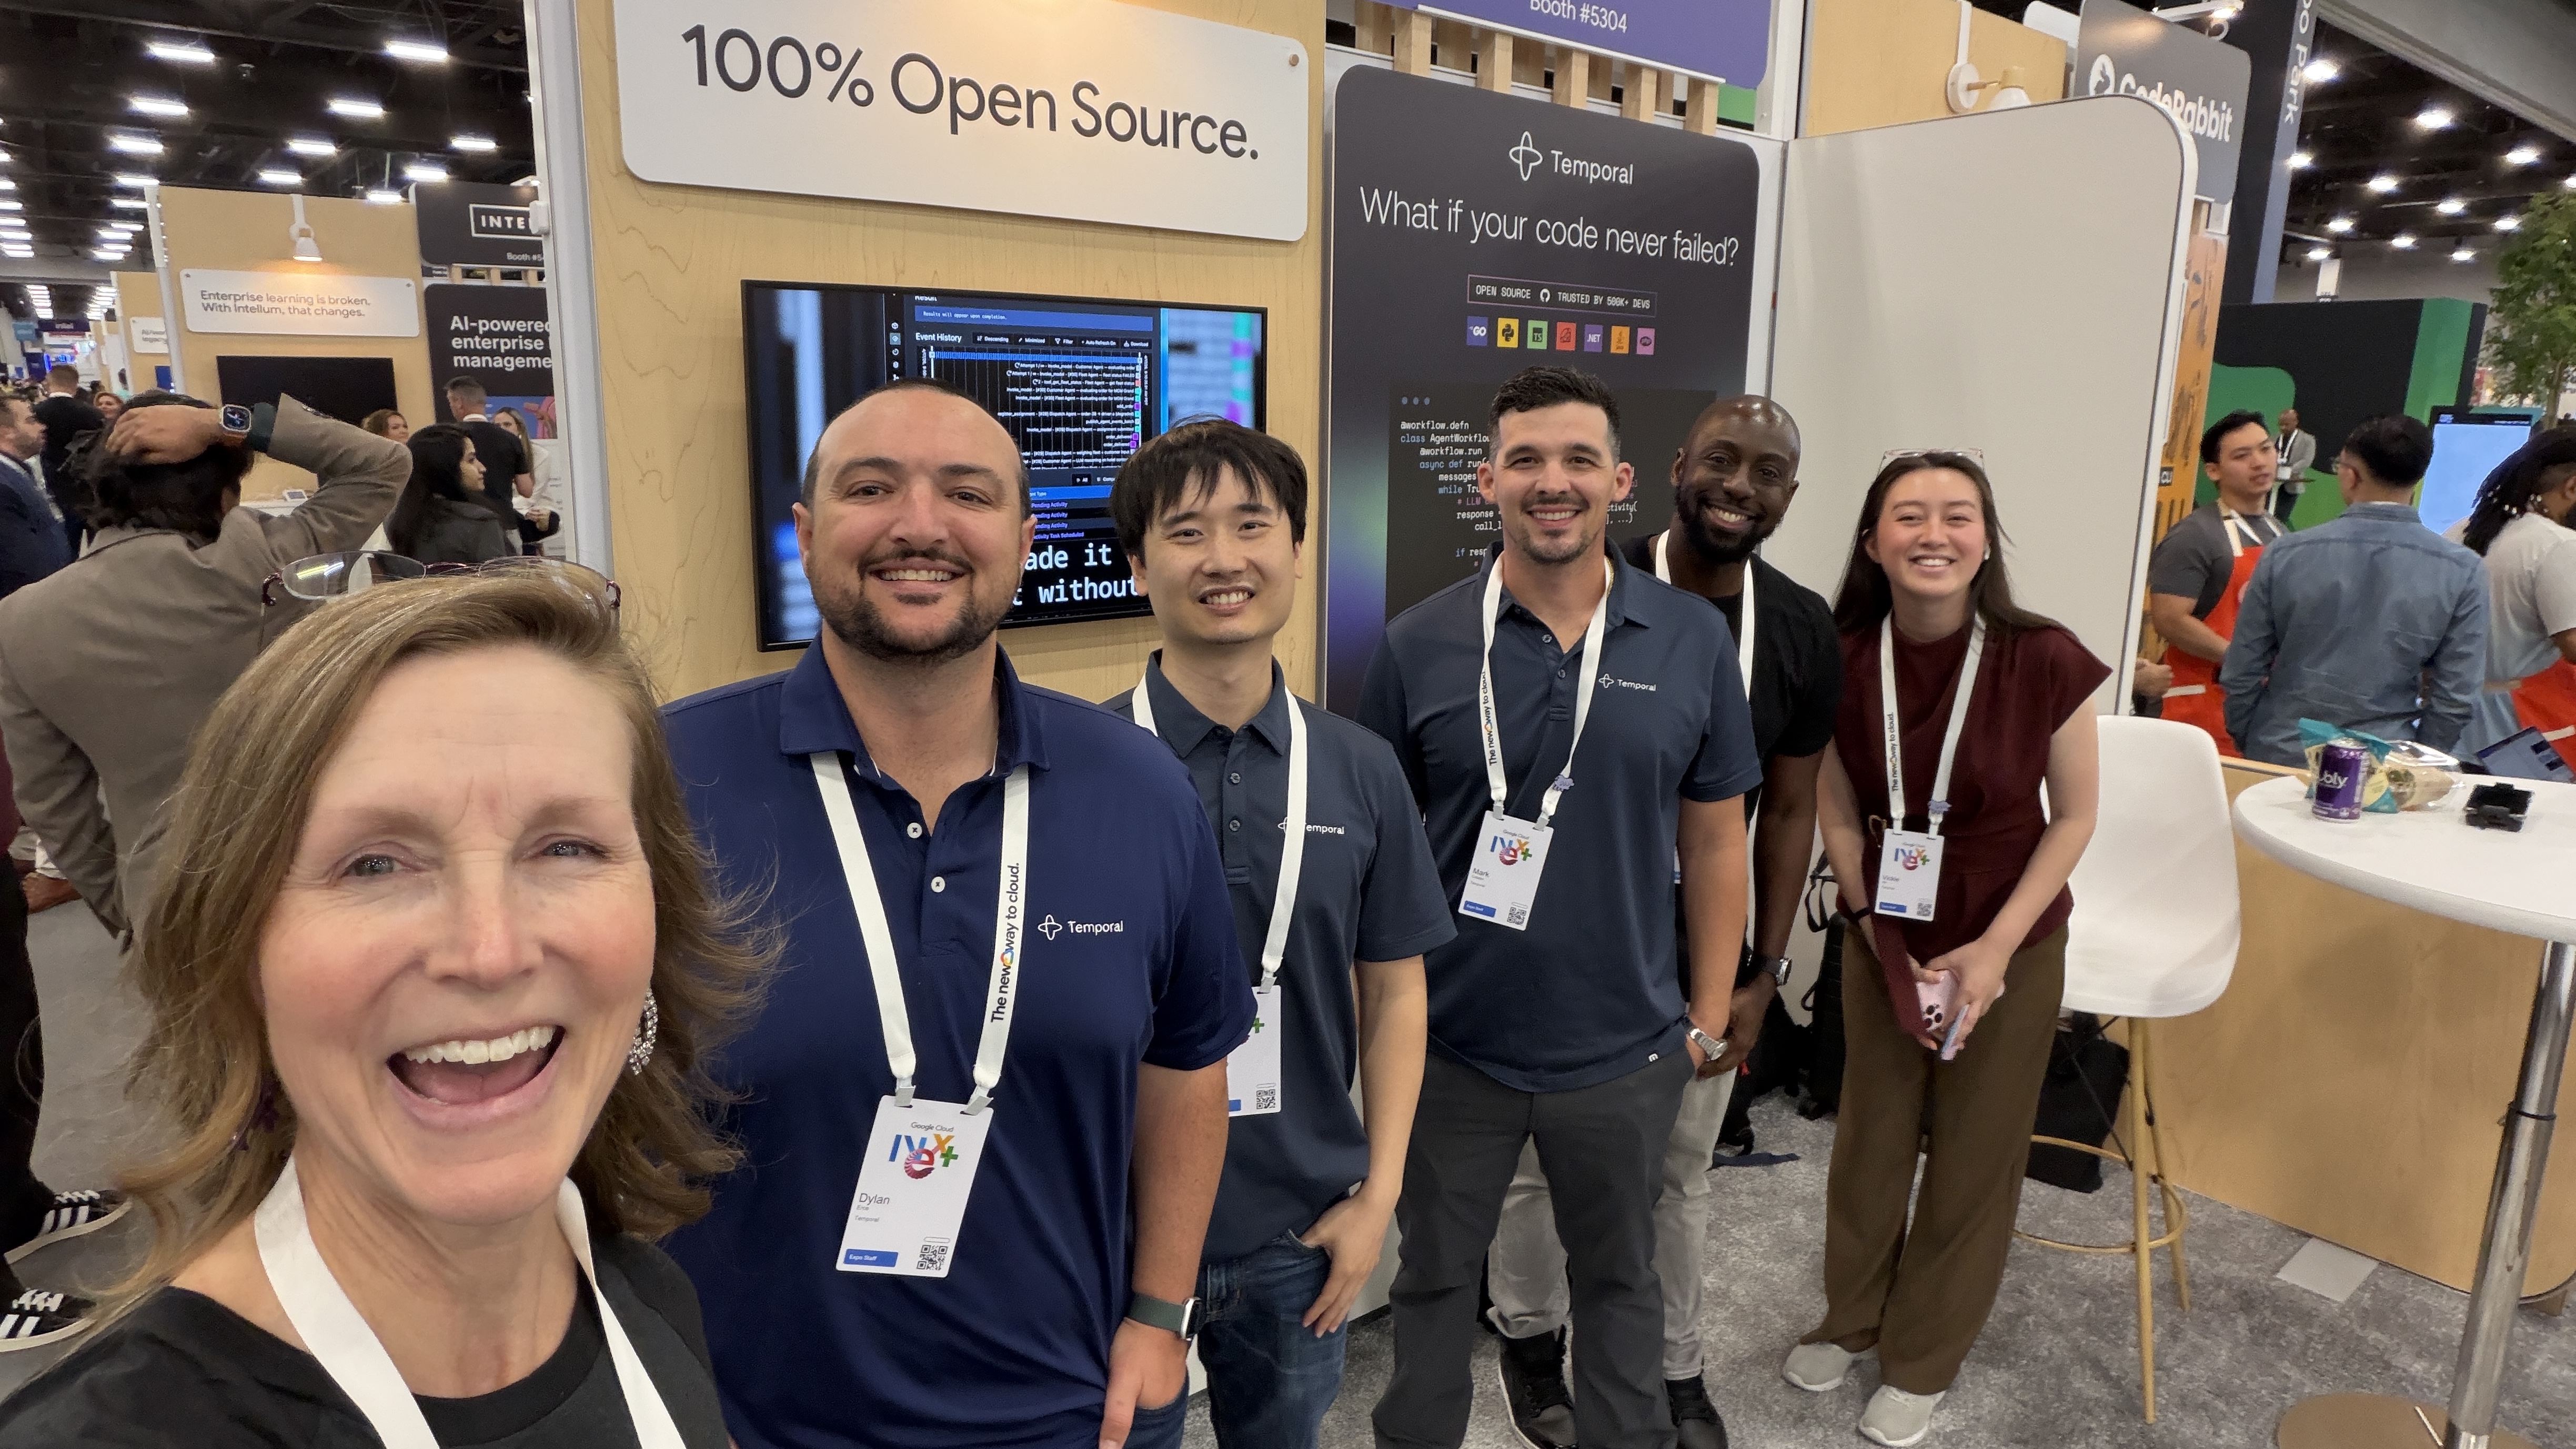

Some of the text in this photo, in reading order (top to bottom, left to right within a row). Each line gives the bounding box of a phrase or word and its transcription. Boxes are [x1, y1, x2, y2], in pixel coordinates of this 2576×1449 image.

[1530, 0, 1628, 33] Booth #5304
[682, 24, 1260, 161] 100% Open Source.
[1551, 150, 1634, 186] Temporal
[480, 215, 530, 229] INTE
[1360, 186, 1739, 266] What if your code never failed?
[507, 253, 530, 261] Booth
[200, 290, 370, 306] Enterprise learning is broken.
[1476, 285, 1651, 309] OPEN SOURCE TRUSTED BY 500K+ DEVS
[202, 303, 365, 318] With Intellum, that changes.
[915, 333, 962, 343] Event History
[1534, 333, 1543, 341] TS
[451, 335, 544, 353] enterprise
[454, 355, 552, 371] manageme
[1401, 420, 1469, 429] @workflow.defn
[1401, 434, 1426, 442] class
[1420, 447, 1482, 456] @workflow.run
[1420, 460, 1444, 470] async
[1448, 459, 1463, 468] def
[1439, 474, 1477, 482] messages
[1438, 484, 1481, 494] while Tru
[1466, 497, 1481, 506] LLM
[1606, 501, 1637, 512] ctivity(
[1457, 510, 1494, 520] response
[1475, 520, 1502, 531] call_l
[1024, 542, 1112, 570] ade it
[1456, 548, 1465, 557] if
[1039, 577, 1138, 604] without
[1617, 679, 1656, 691] Temporal
[1483, 695, 1489, 705] to
[1889, 733, 1896, 742] to
[1489, 750, 1497, 766] The
[1305, 822, 1345, 834] emporal
[1473, 868, 1491, 878] Mark
[1068, 920, 1123, 936] Temporal
[991, 862, 1020, 1023] The new way to cloud.
[911, 1122, 934, 1131] Google
[859, 1193, 890, 1205] Dylan
